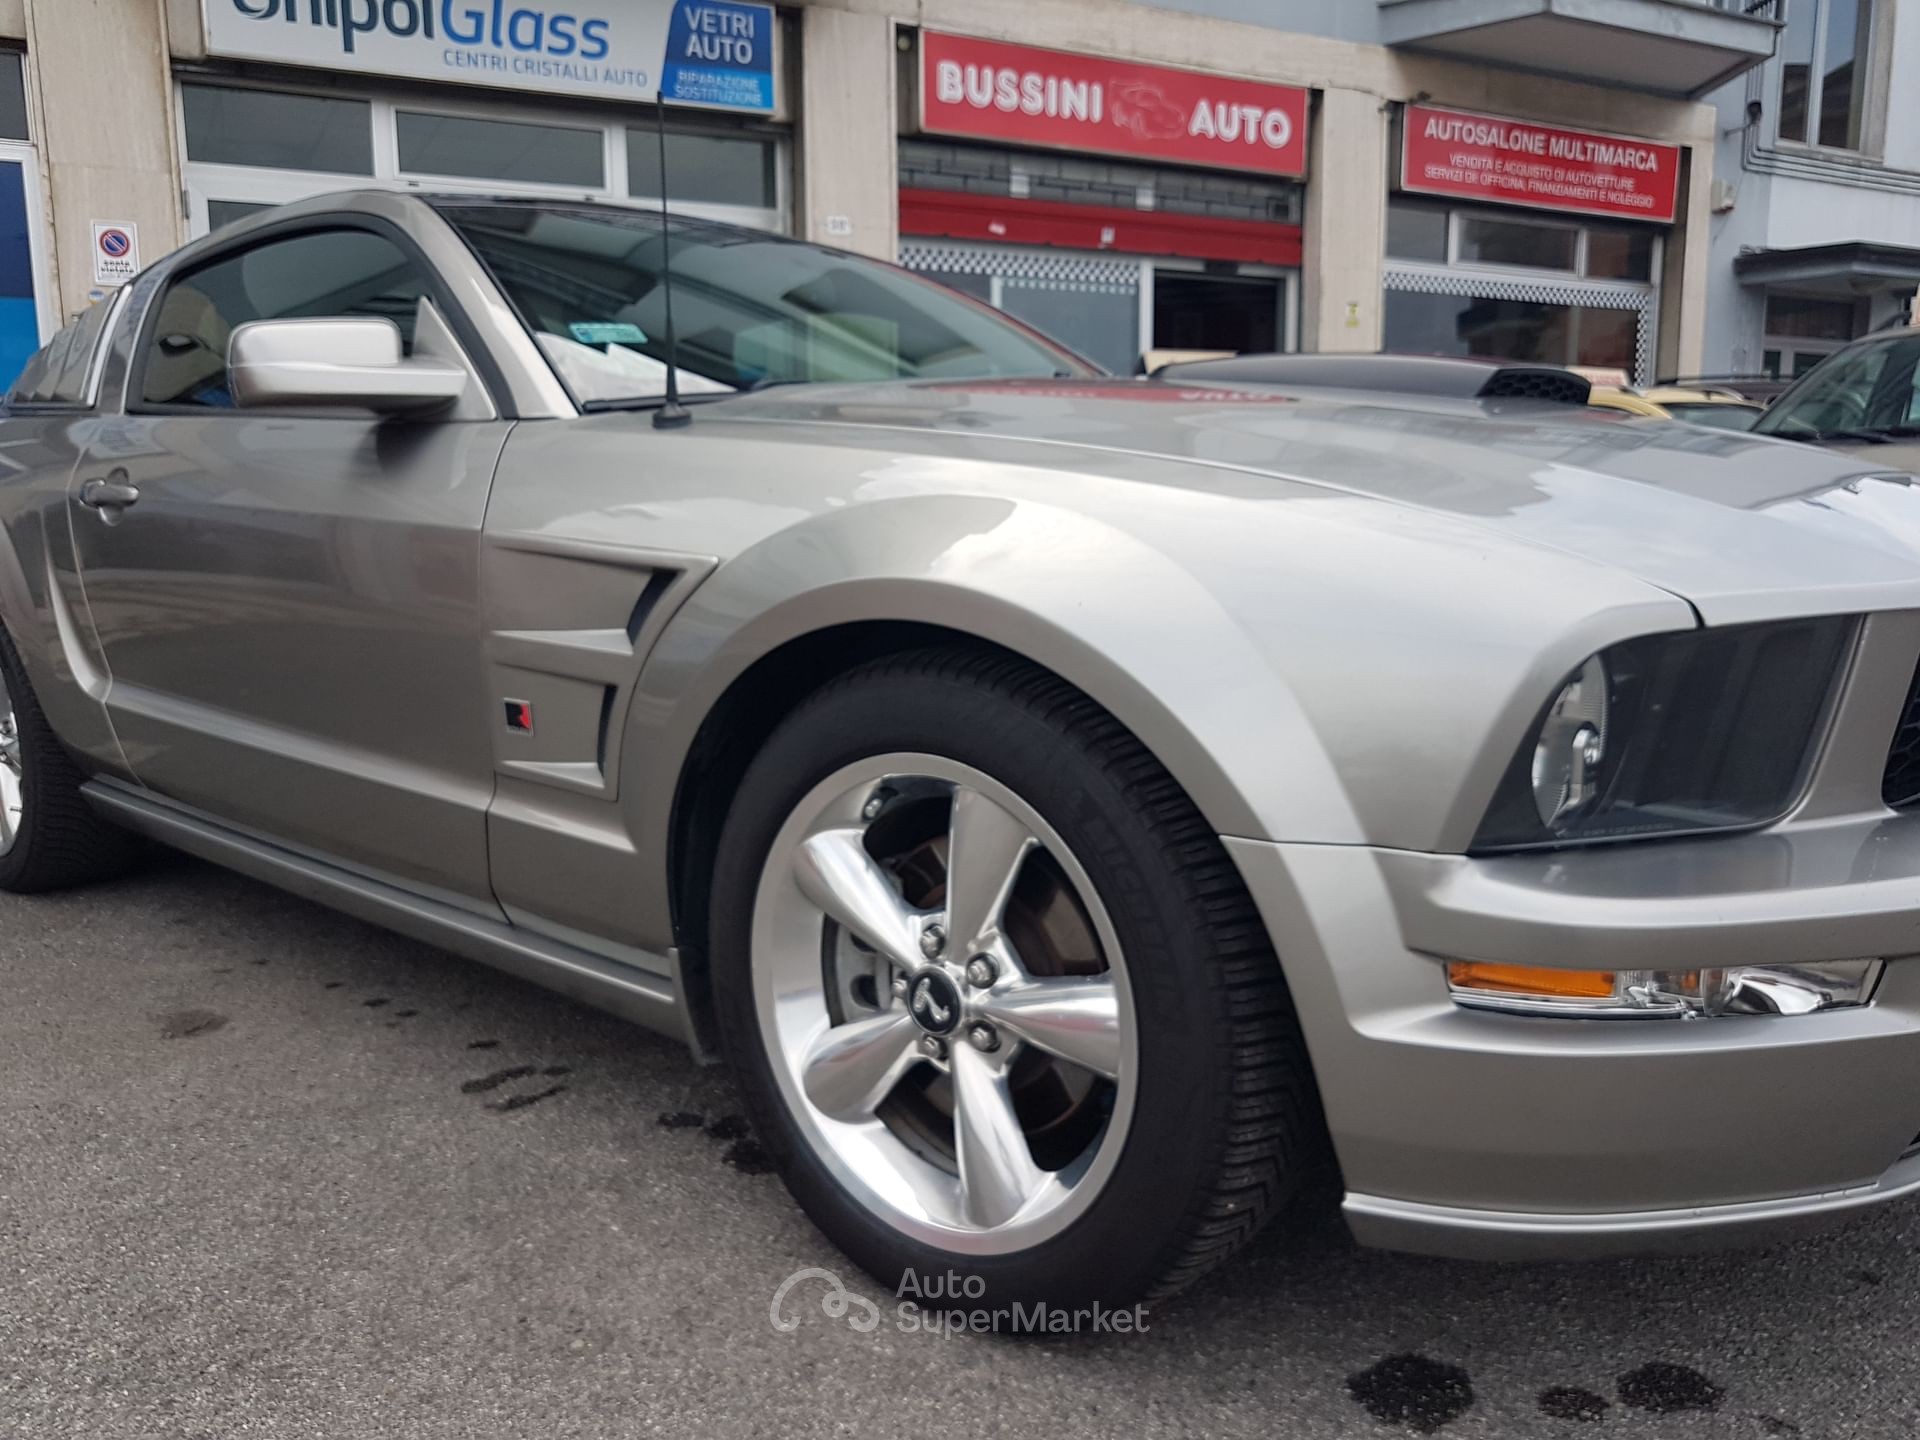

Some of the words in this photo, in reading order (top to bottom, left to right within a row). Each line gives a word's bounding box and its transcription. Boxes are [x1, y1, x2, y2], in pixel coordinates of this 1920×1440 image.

[683, 4, 754, 39] VETRI
[685, 31, 753, 65] AUTO
[443, 50, 508, 72] CENTRI
[513, 57, 599, 82] CRISTALLI
[604, 68, 649, 88] AUTO
[936, 60, 1104, 123] BUSSINI
[1188, 98, 1292, 149] AUTO
[1424, 117, 1544, 155] AUTOSALONE
[1549, 134, 1658, 172] MULTIMARCA
[1424, 166, 1463, 182] SERVIZI
[1528, 179, 1598, 200] FINANZIAMENTI
[1607, 190, 1655, 208] NOLEGGIO
[1449, 153, 1493, 171] VENDITA
[1503, 161, 1552, 180] ACQUISTO
[1565, 169, 1635, 191] AUTOVETTURE
